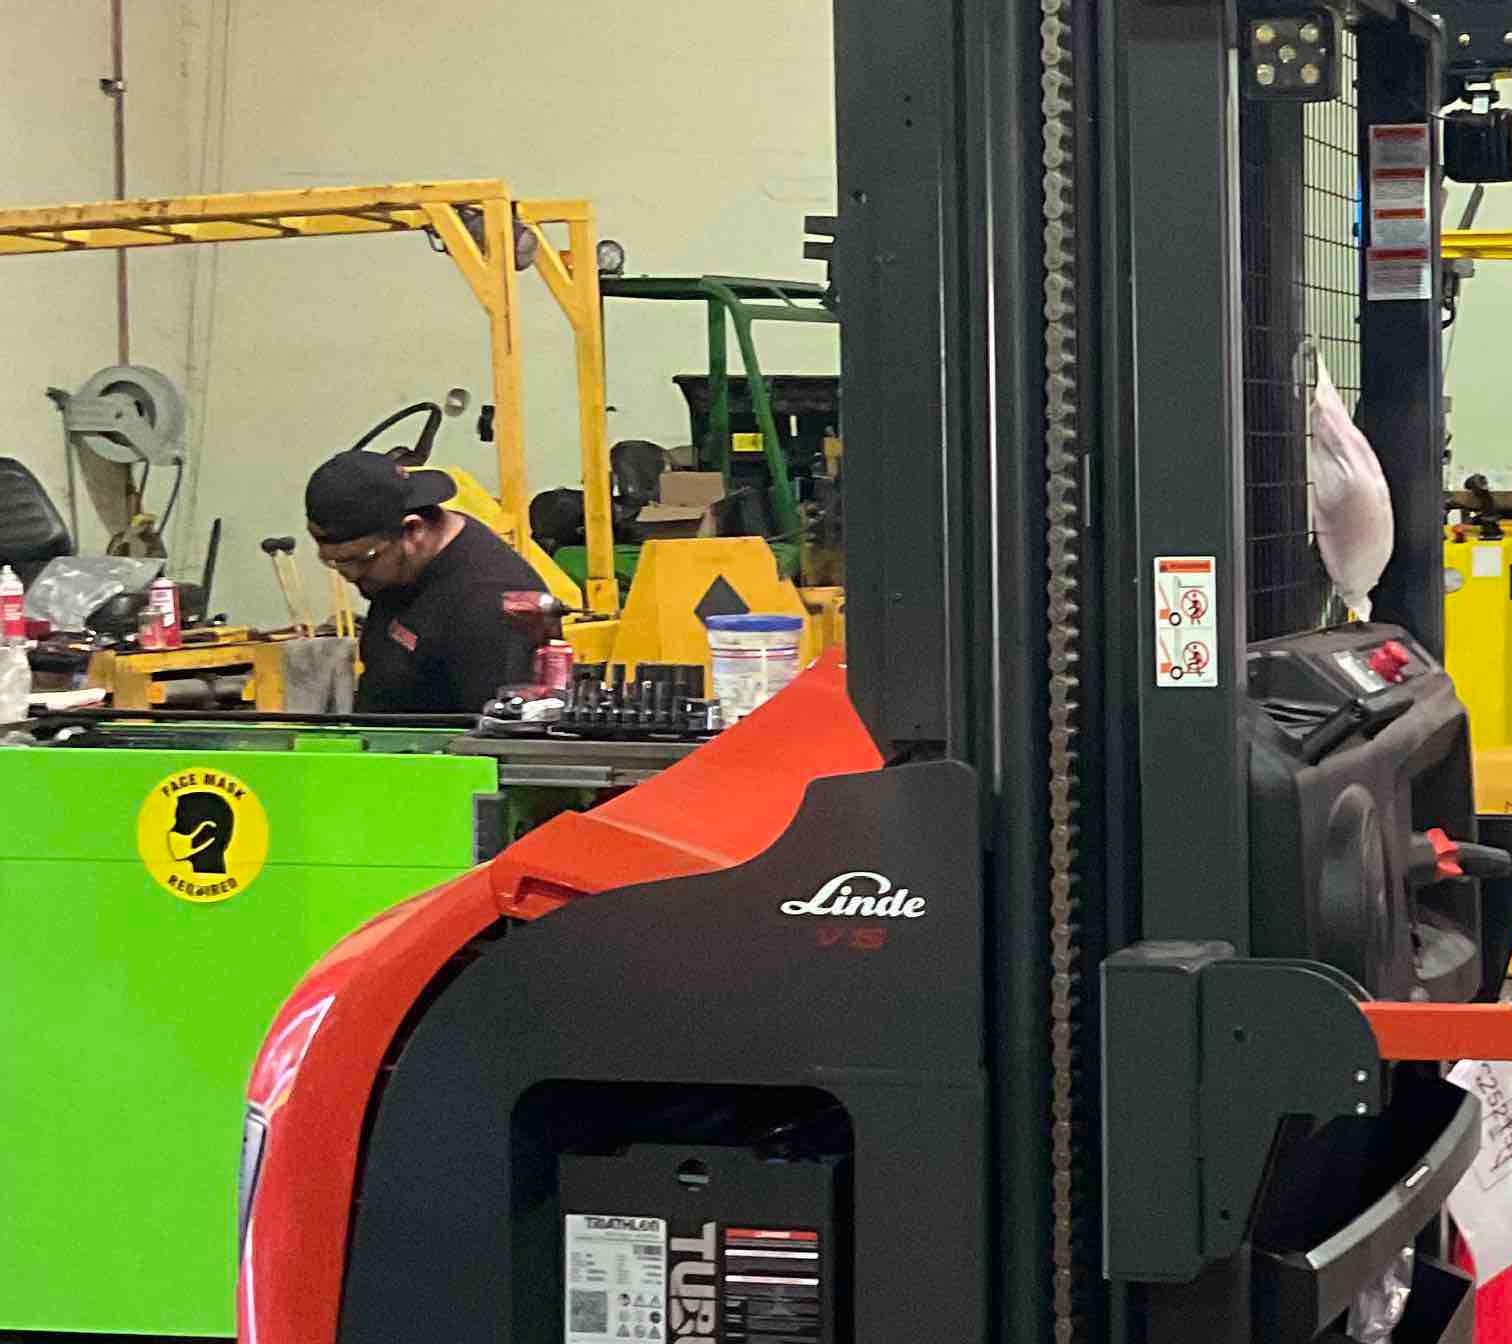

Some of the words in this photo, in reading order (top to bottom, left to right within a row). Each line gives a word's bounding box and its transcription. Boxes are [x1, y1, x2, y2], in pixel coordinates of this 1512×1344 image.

[162, 773, 197, 798] FACE
[204, 773, 246, 800] MASK
[168, 873, 238, 897] REQUIRED
[780, 871, 926, 918] Linde
